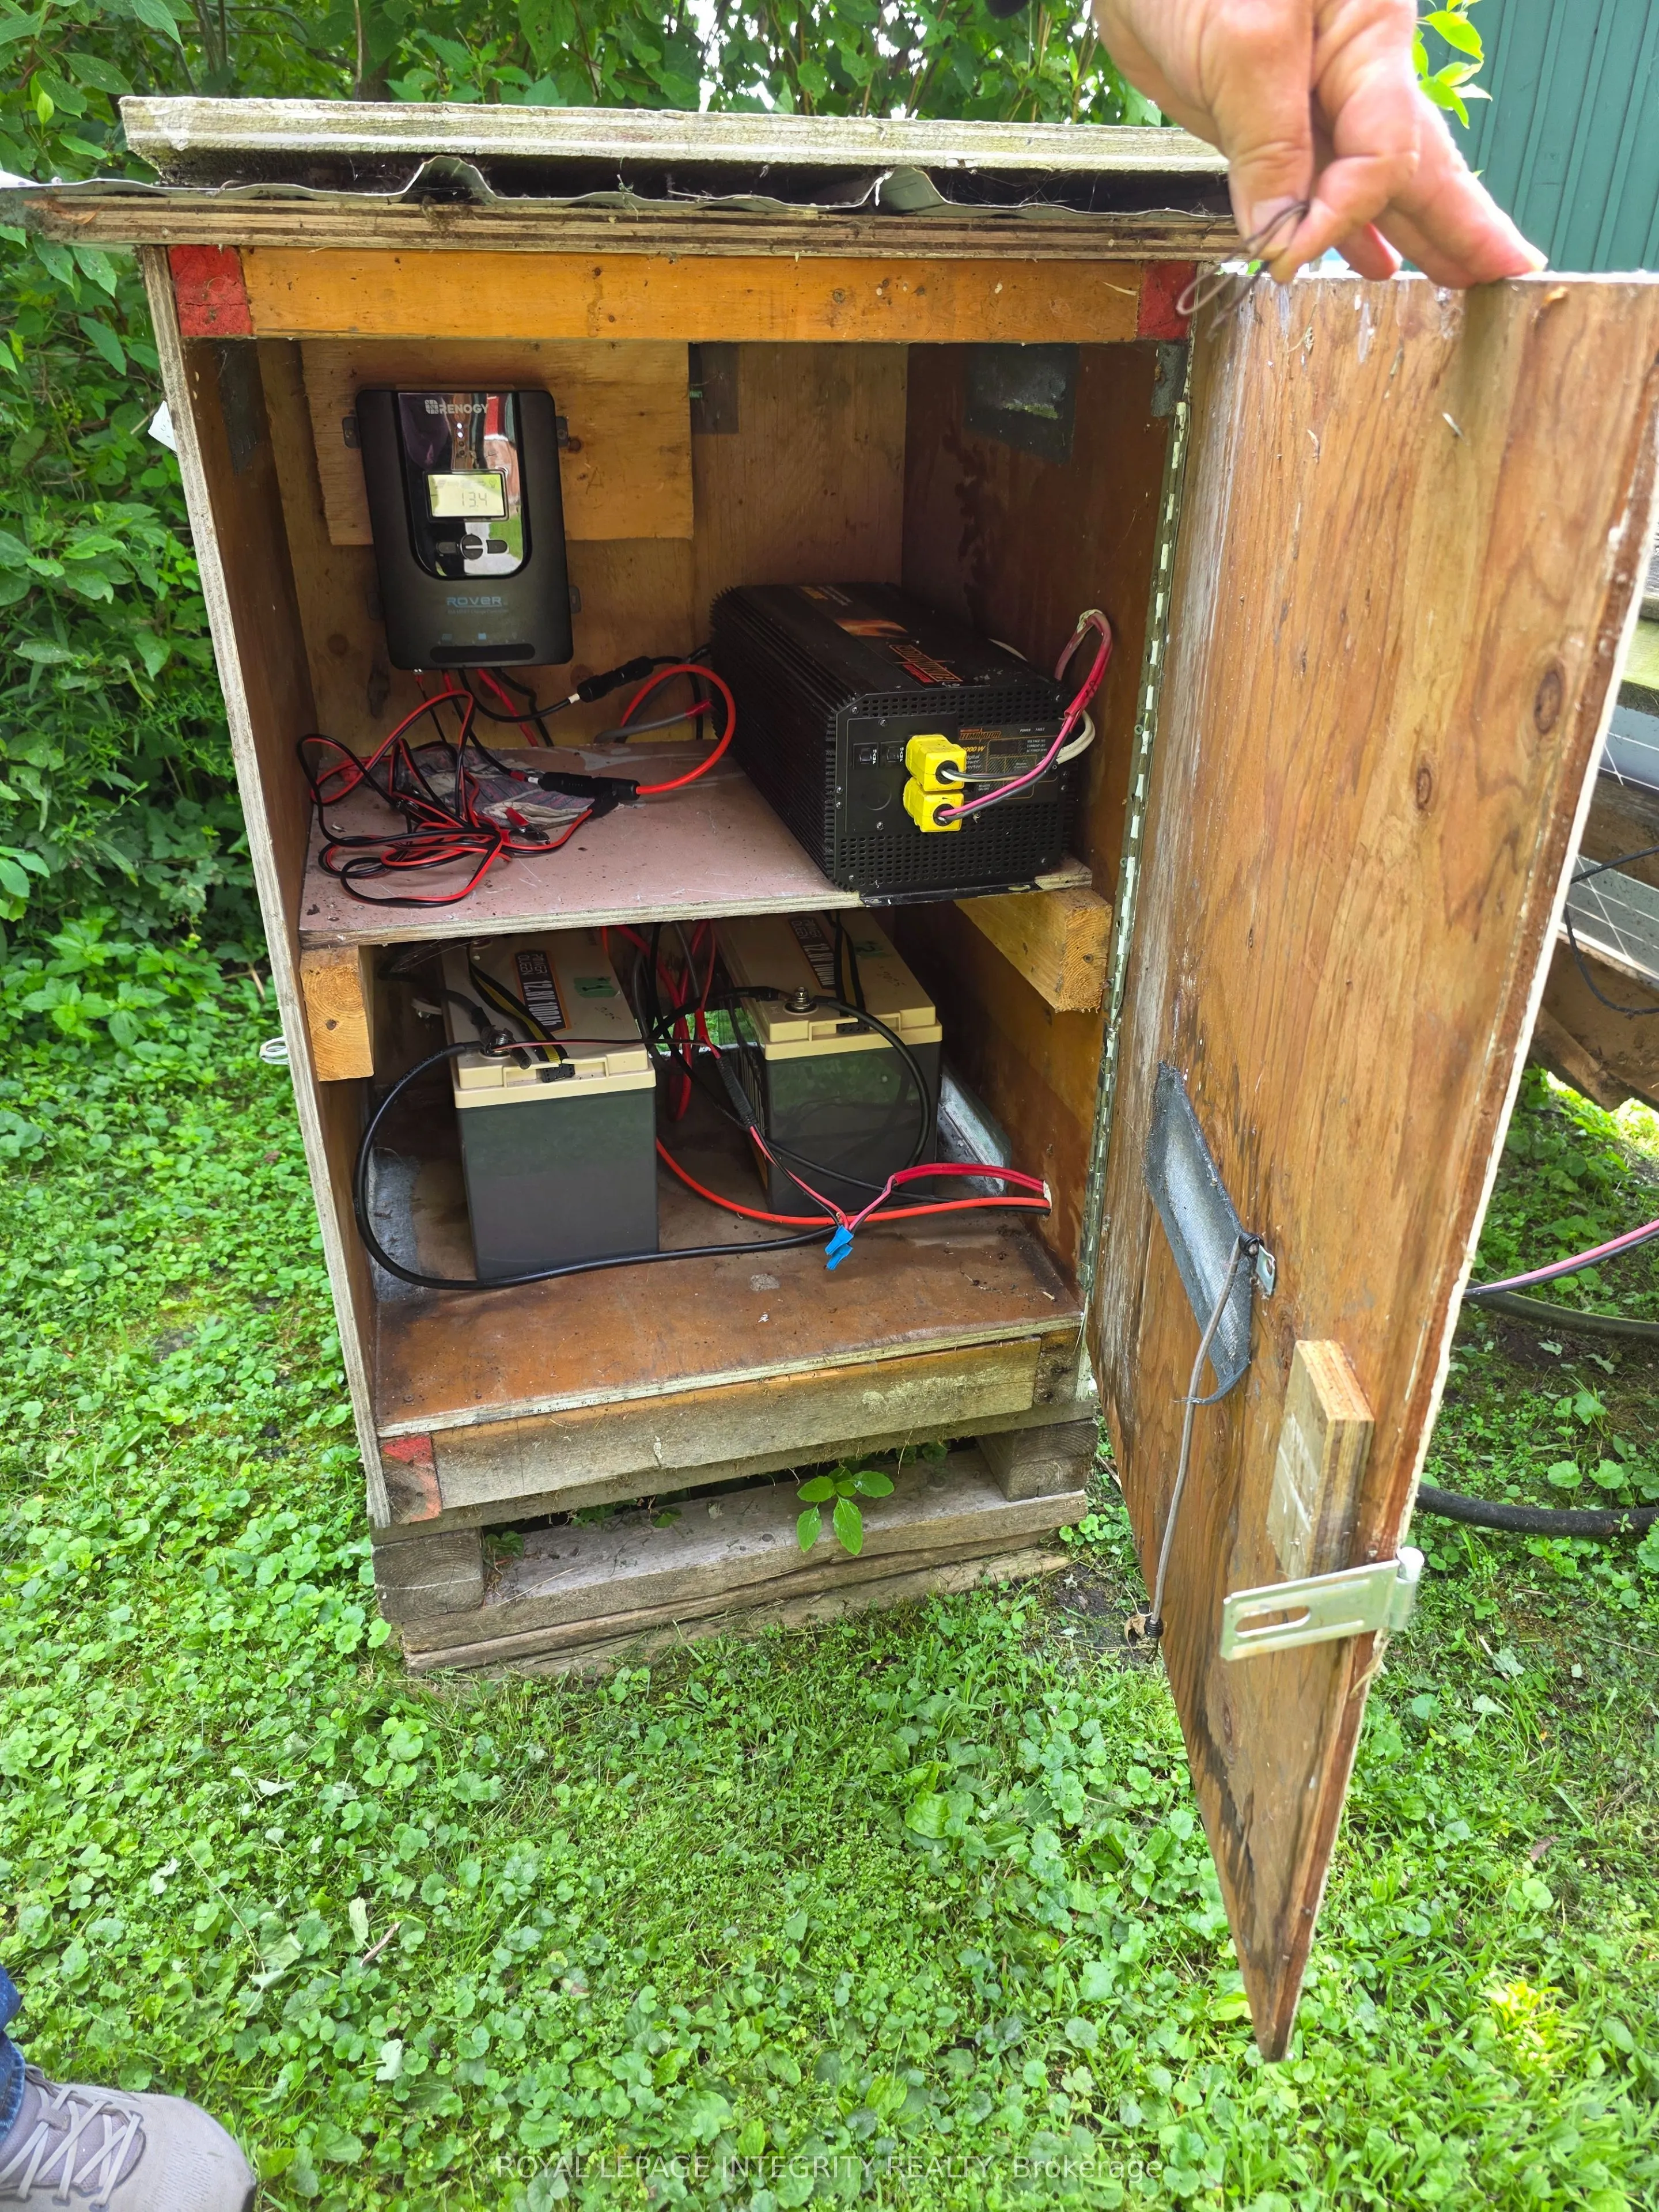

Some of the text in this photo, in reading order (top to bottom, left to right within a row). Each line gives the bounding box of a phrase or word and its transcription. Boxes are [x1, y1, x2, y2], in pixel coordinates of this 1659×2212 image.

[439, 404, 488, 414] RENOGY
[446, 597, 502, 607] ROVER
[960, 730, 1001, 741] ELIMINATOR
[518, 954, 534, 975] QUEEN
[531, 953, 547, 975] POWER
[523, 980, 556, 1001] 12.8V
